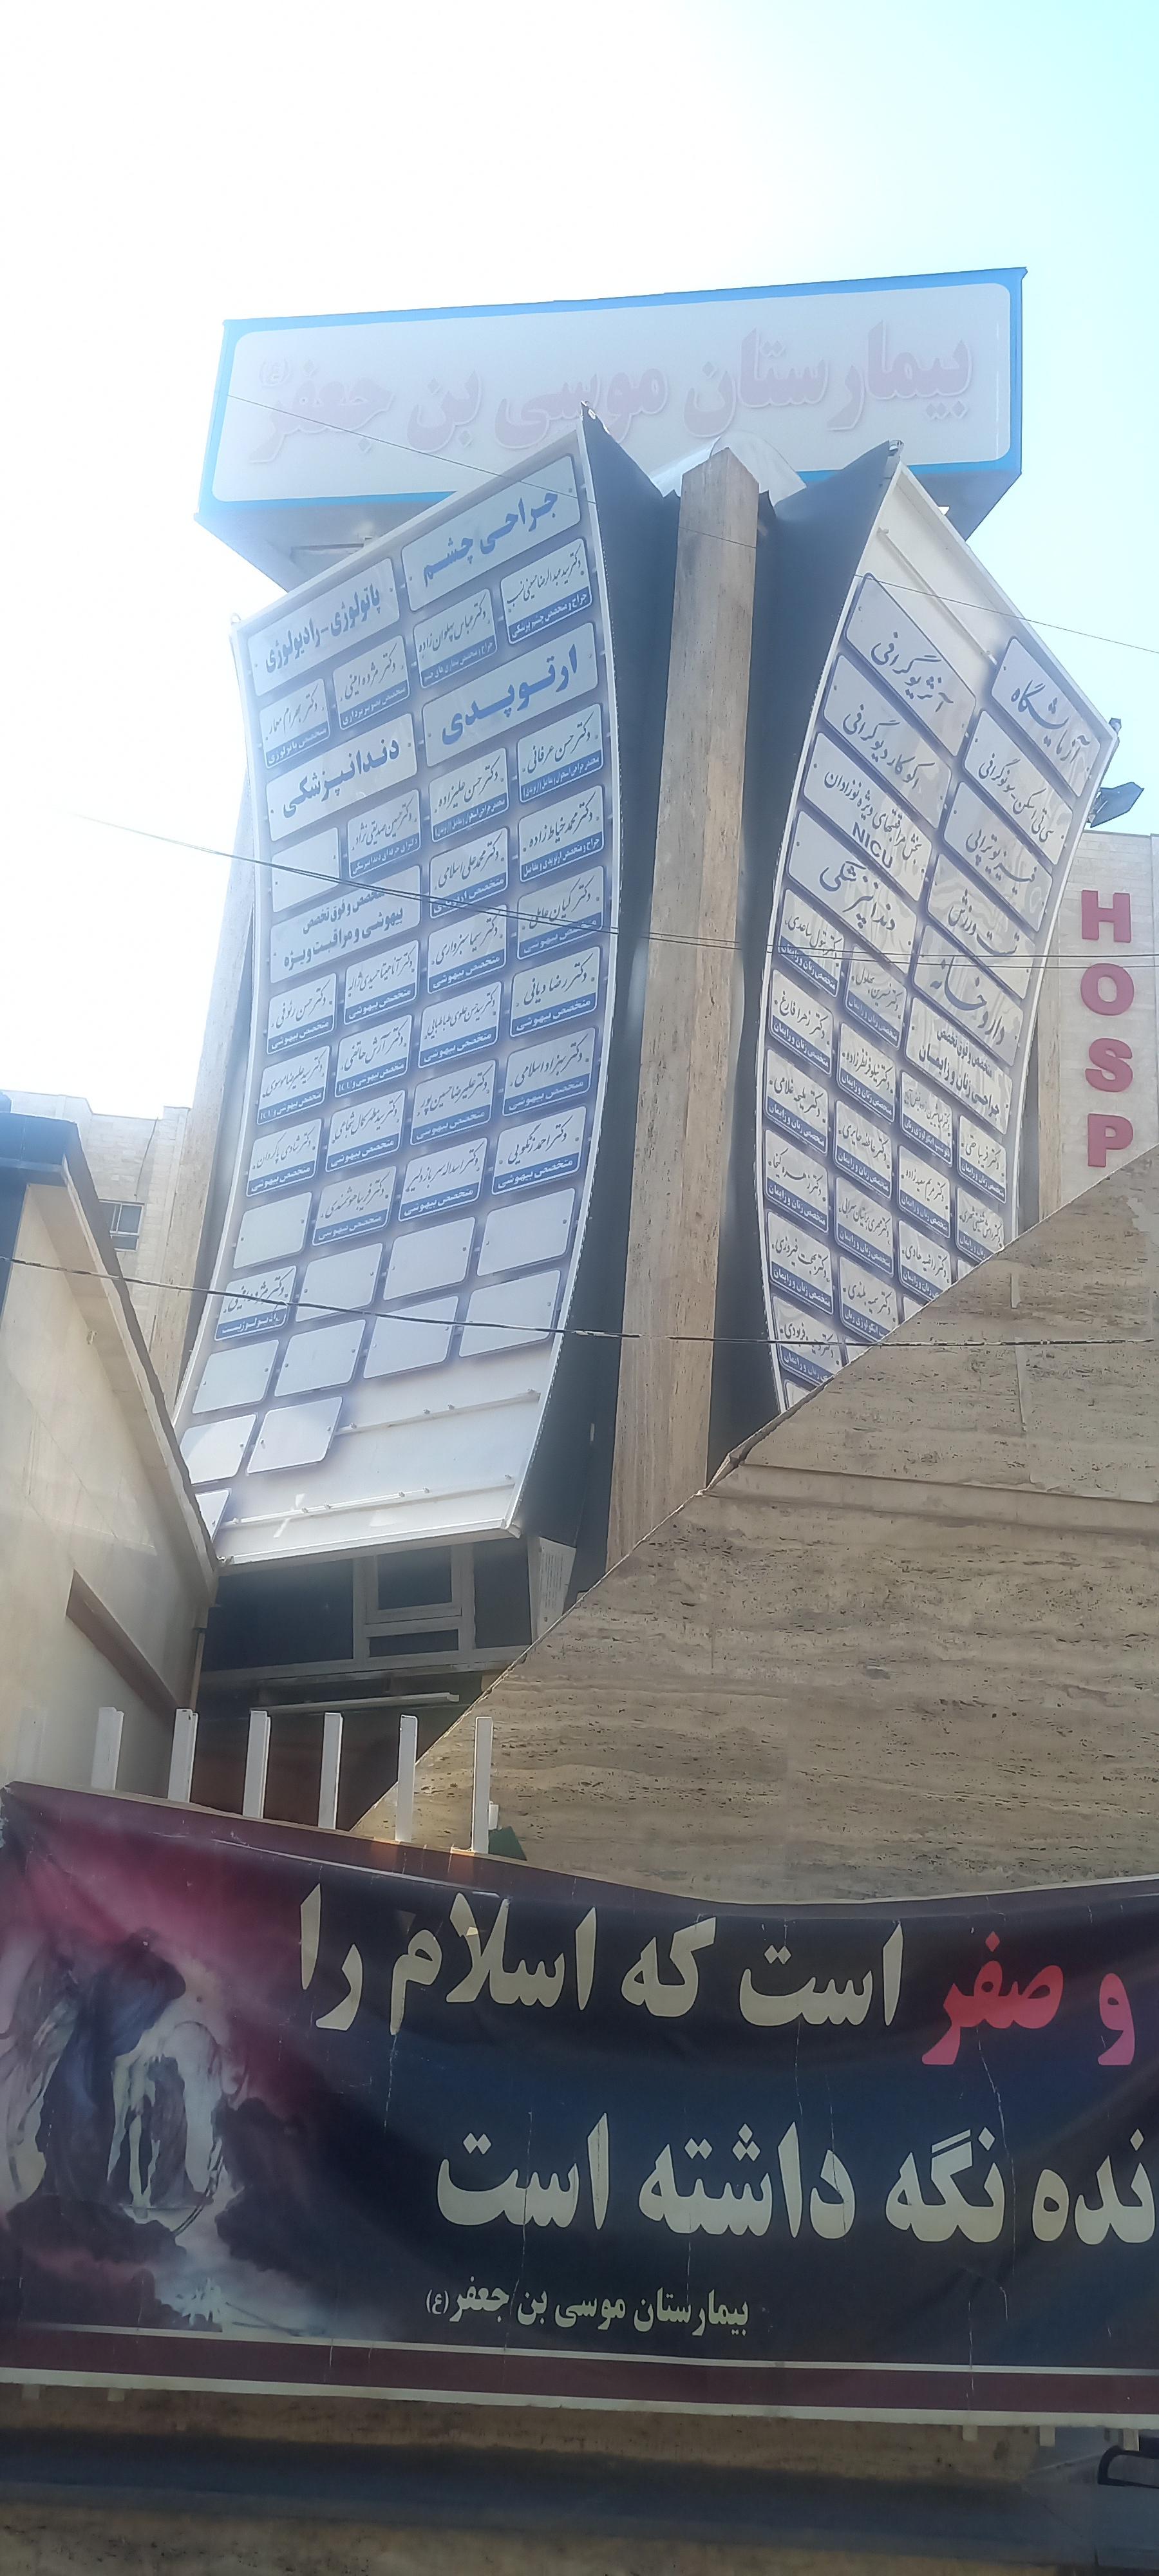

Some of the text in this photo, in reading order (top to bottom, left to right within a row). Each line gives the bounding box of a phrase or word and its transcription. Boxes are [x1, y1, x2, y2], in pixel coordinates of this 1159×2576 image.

[684, 320, 972, 438] بیمارستان
[248, 362, 395, 464] جعفر
[407, 369, 483, 453] بن
[494, 366, 668, 450] موسی
[423, 493, 558, 587] جراحی چشم
[441, 643, 578, 746] ارتوپدی
[527, 710, 594, 774] دکتر حسن عرفانی
[1010, 679, 1091, 764] آزمایشگاه
[283, 739, 400, 819] دندانپزشکی
[479, 755, 502, 796] دکتر
[572, 791, 596, 835] دکتر
[852, 821, 894, 869] NICU
[361, 906, 404, 940] بیهوشی
[432, 956, 501, 989] متخصص بیهوشی
[549, 974, 567, 992] رضا
[564, 952, 594, 992] دکتر
[515, 999, 591, 1032] متخصص بیهوشی
[423, 1033, 492, 1063] متخصص بیهوشی
[560, 1033, 589, 1074] دکتر
[508, 1082, 585, 1112] متخصص بیهوشی
[415, 1110, 487, 1141] متخصص بیهوشی
[546, 1115, 573, 1152] دکتر
[496, 1158, 574, 1189] متخصص بیهوشی
[404, 1189, 475, 1217] متخصص بیهوشی
[299, 1882, 1137, 2066] و صفر است که اسلام را
[435, 2112, 610, 2231] است
[637, 2120, 858, 2241] داشته
[884, 2125, 1007, 2245] نگه
[424, 2275, 750, 2338] بیمارستان موسی بن جعفر (ع)
